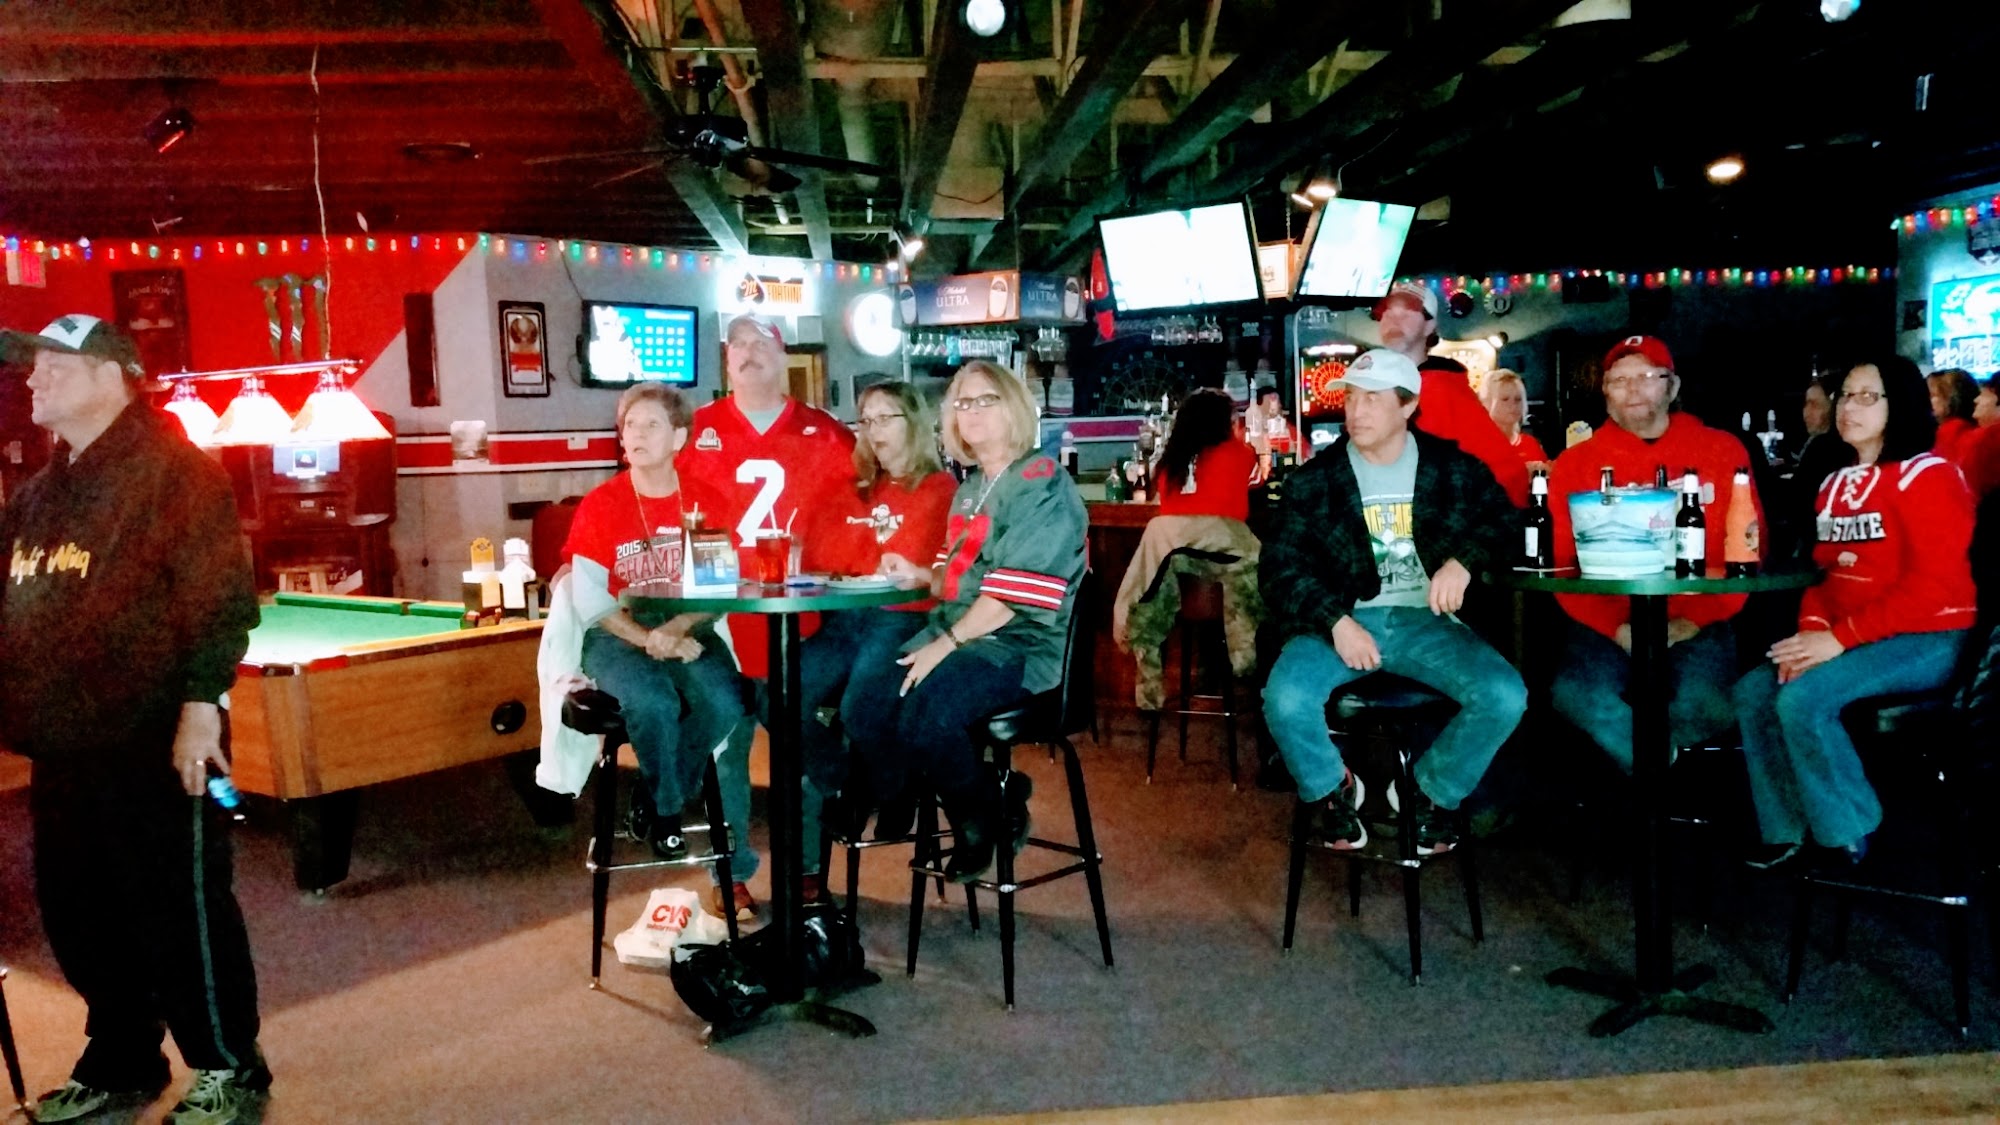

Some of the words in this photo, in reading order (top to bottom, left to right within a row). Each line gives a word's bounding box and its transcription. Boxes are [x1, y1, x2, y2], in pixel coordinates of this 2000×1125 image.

[936, 296, 970, 308] ULTRA
[1028, 290, 1058, 302] ULTRA
[736, 459, 785, 547] 2
[1832, 512, 1887, 542] STATE
[616, 540, 641, 559] 2015
[651, 904, 692, 929] CVS
